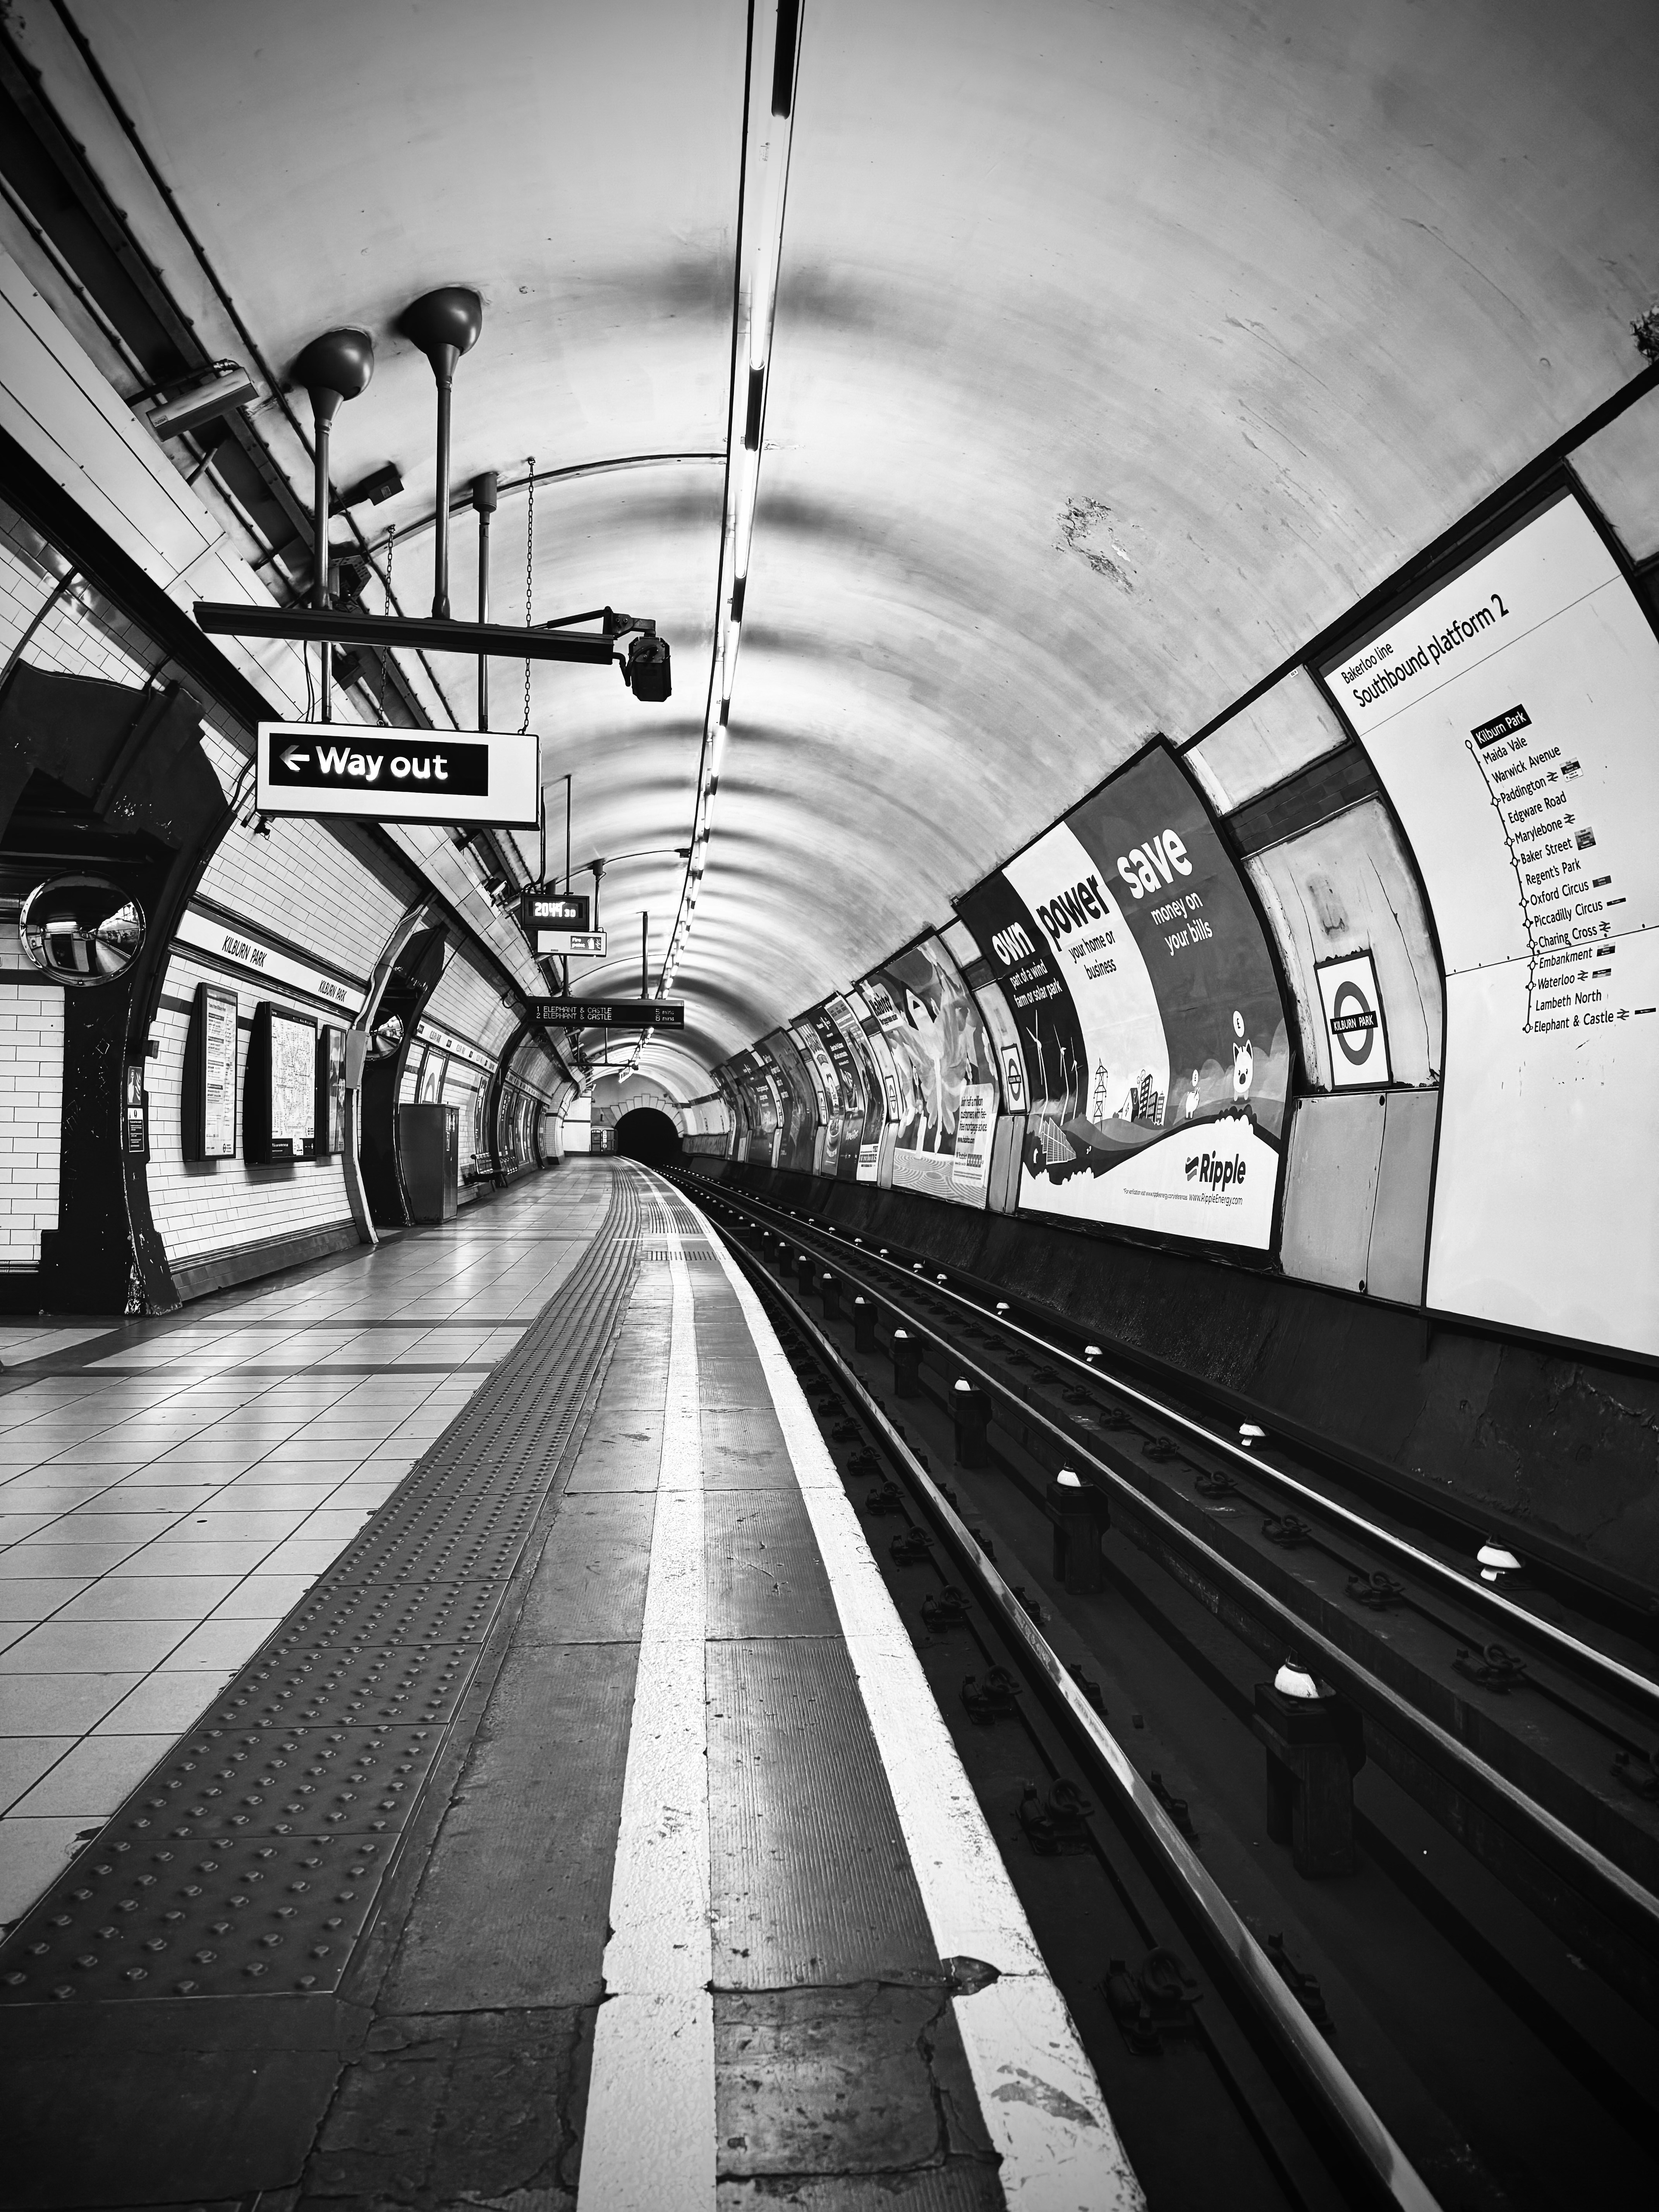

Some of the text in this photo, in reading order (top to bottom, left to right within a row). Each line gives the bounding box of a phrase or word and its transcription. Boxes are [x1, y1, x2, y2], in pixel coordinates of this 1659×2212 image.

[1341, 644, 1393, 684] Bakerloo line
[1353, 594, 1509, 707] Southbound platform 2
[1476, 712, 1526, 744] Kilburn Park
[316, 746, 448, 781] Way out
[1483, 737, 1527, 764] Maida Vale
[1491, 747, 1561, 783] Warwick Avenue
[1500, 778, 1546, 804] Paddington
[1508, 791, 1566, 823] Edgware Road
[1515, 820, 1563, 844] Marylebone
[1118, 830, 1192, 898] save
[1521, 850, 1542, 864] Baker
[1546, 838, 1573, 856] Street
[1526, 859, 1581, 885] Regent's Park
[1531, 882, 1589, 905] Oxford Circus
[1036, 875, 1109, 951] power
[1151, 893, 1203, 925] money on
[1534, 908, 1571, 927] Piccadilly
[1576, 902, 1602, 915] Circus
[993, 922, 1035, 965] own
[1068, 931, 1116, 963] your home or
[1164, 919, 1212, 956] your bills
[1539, 926, 1597, 945] Charing Cross
[222, 936, 267, 967] KILBURN PARK
[1540, 948, 1592, 969] Embankment
[1010, 960, 1048, 989] part of a wind
[1085, 959, 1116, 980] business
[1538, 974, 1575, 989] Waterloo
[319, 980, 347, 1002] KILBURN PARK
[1014, 980, 1062, 1008] farm or solar park
[1536, 989, 1601, 1011] Lambeth North
[1334, 1015, 1374, 1030] KILBURN PARK
[1535, 1011, 1613, 1033] Elephant & Castle
[1199, 1151, 1245, 1192] Ripple
[1190, 1194, 1242, 1206] www.RippleEnergy.com
